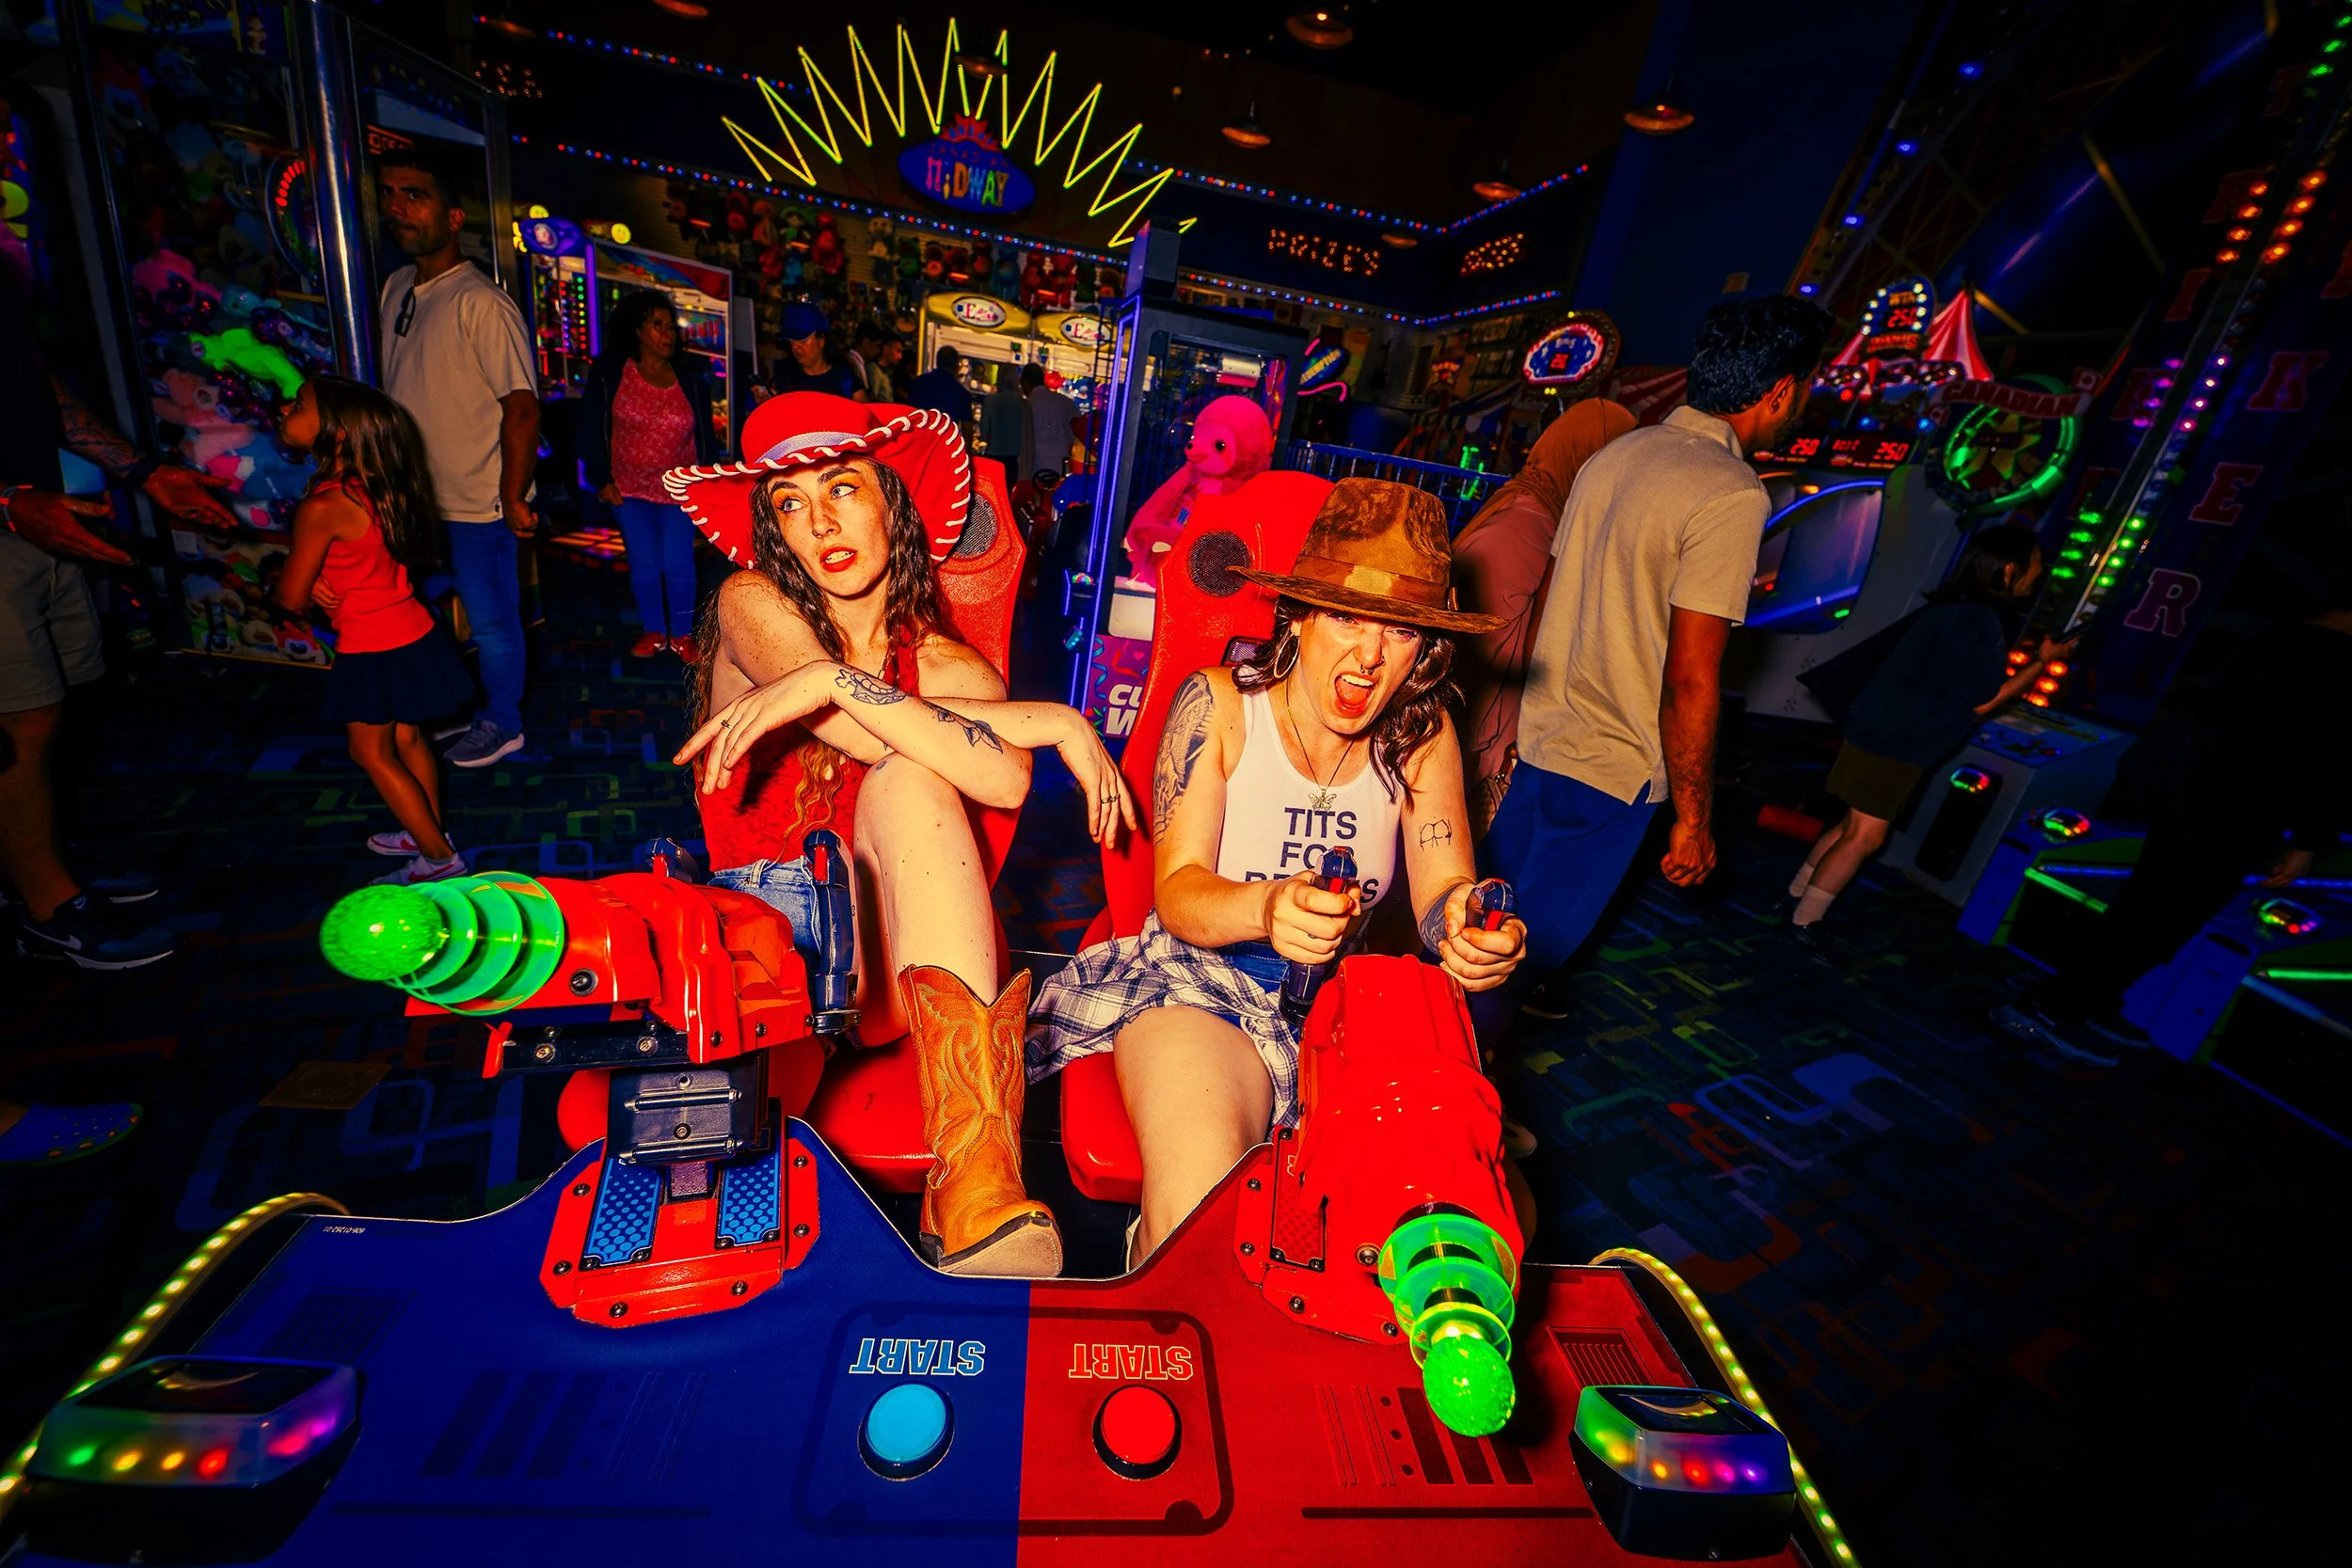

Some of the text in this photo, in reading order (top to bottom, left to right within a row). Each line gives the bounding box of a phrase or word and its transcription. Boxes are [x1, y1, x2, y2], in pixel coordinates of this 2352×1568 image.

[1266, 228, 1381, 277] PRIZES
[1942, 382, 2081, 419] CANADIAN
[1789, 437, 1821, 456] 250
[1873, 441, 1911, 462] 250
[1283, 806, 1358, 840] TITS
[1279, 841, 1355, 870] FO
[848, 1338, 987, 1376] START
[1068, 1342, 1194, 1380] START
